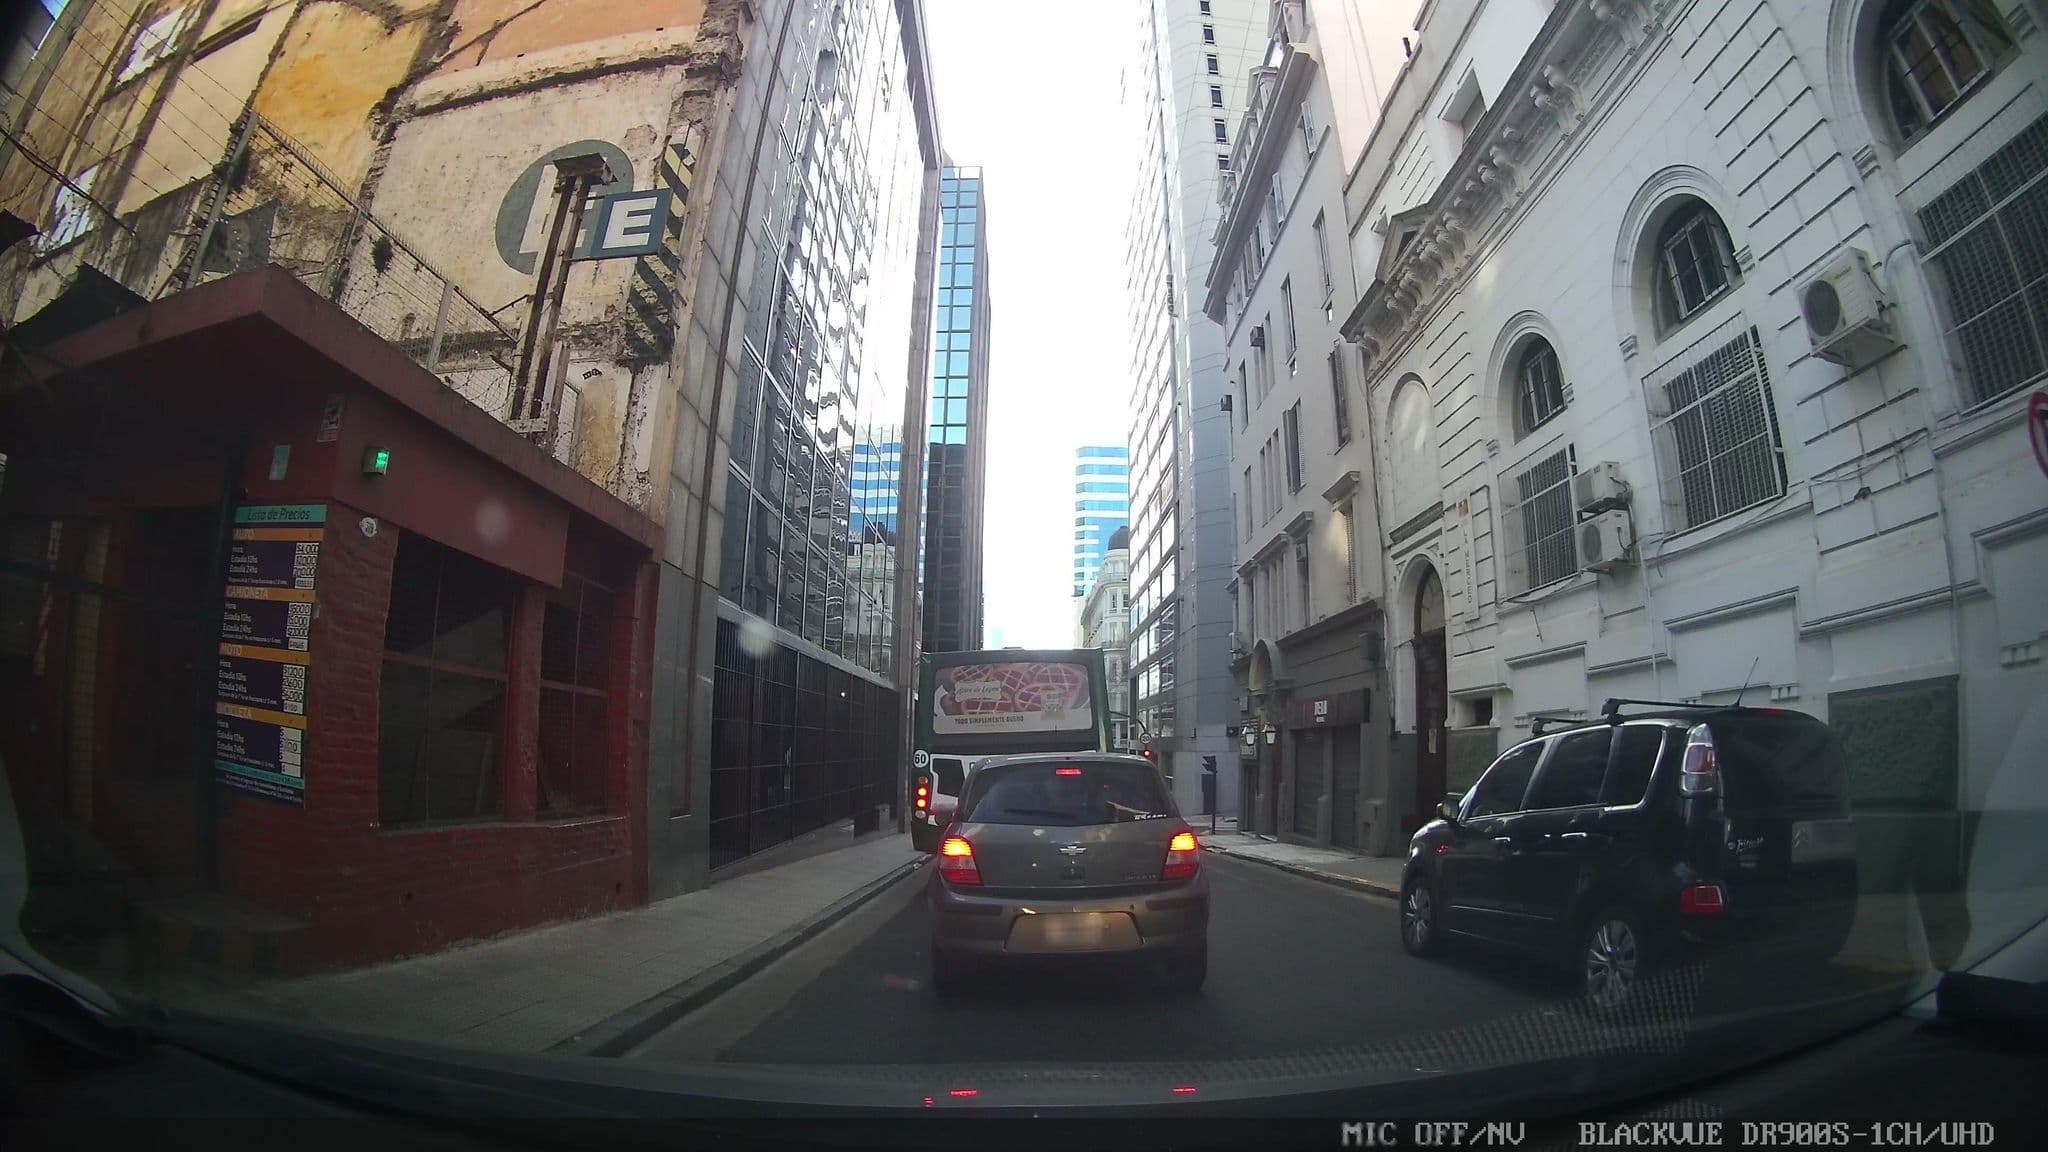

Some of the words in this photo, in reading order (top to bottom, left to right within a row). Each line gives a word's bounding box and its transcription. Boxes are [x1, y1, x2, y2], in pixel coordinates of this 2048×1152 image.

[602, 197, 657, 249] E
[267, 509, 278, 520] de
[279, 508, 310, 520] Precios
[226, 586, 269, 599] CAMIONETA
[969, 716, 1005, 725] SIMPLEMENTE
[915, 754, 926, 764] 60
